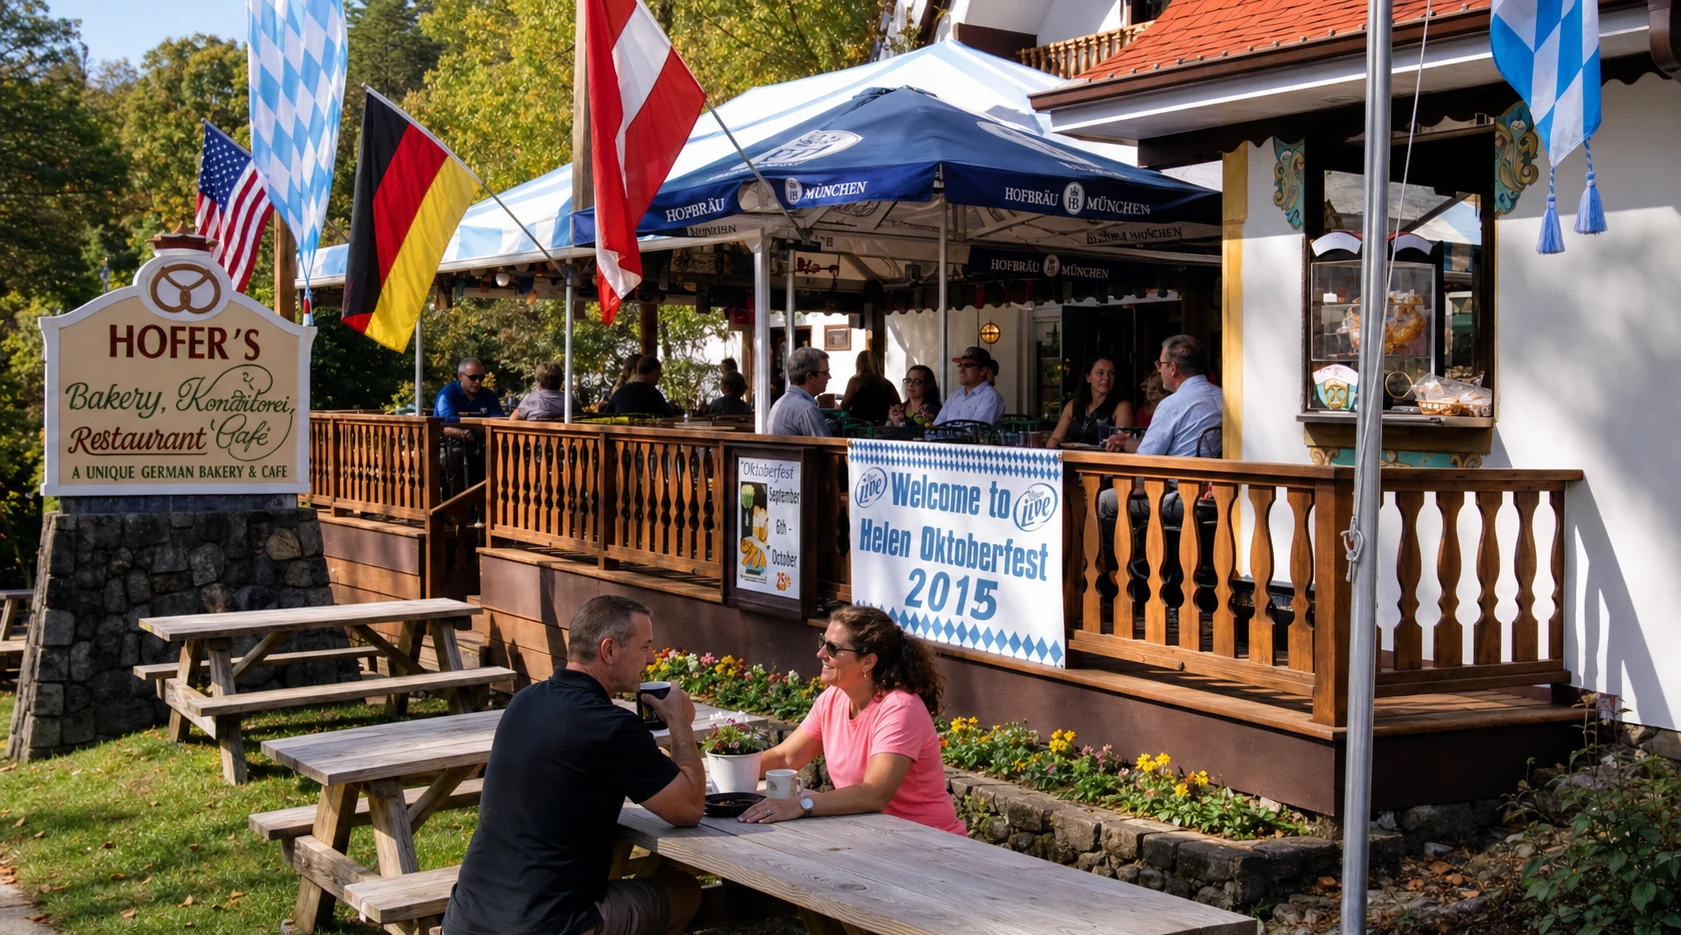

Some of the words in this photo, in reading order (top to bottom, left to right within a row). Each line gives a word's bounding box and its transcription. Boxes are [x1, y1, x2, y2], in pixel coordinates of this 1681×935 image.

[665, 197, 726, 223] HOFBRÄU
[803, 180, 868, 201] MÜNCHEN
[1004, 186, 1059, 207] HOFBRÄU
[1086, 195, 1151, 216] MÜNCHEN
[990, 258, 1040, 274] HOFBRÄU
[1061, 264, 1109, 280] MÜNCHEN
[109, 324, 261, 361] HOFER'S
[65, 382, 167, 418] Bakery,
[67, 426, 208, 456] Restaurant
[72, 466, 81, 480] A
[86, 466, 135, 481] UNIQUE
[141, 465, 194, 479] GERMAN
[199, 465, 244, 479] BAKERY
[248, 465, 257, 479] &
[261, 465, 288, 479] CAFE
[769, 486, 800, 506] September
[891, 471, 981, 515] Welcome
[989, 481, 1011, 520] to
[772, 549, 797, 569] October
[859, 518, 911, 558] Helen
[920, 525, 1049, 582] Oktoberfest
[904, 568, 999, 621] 2015
